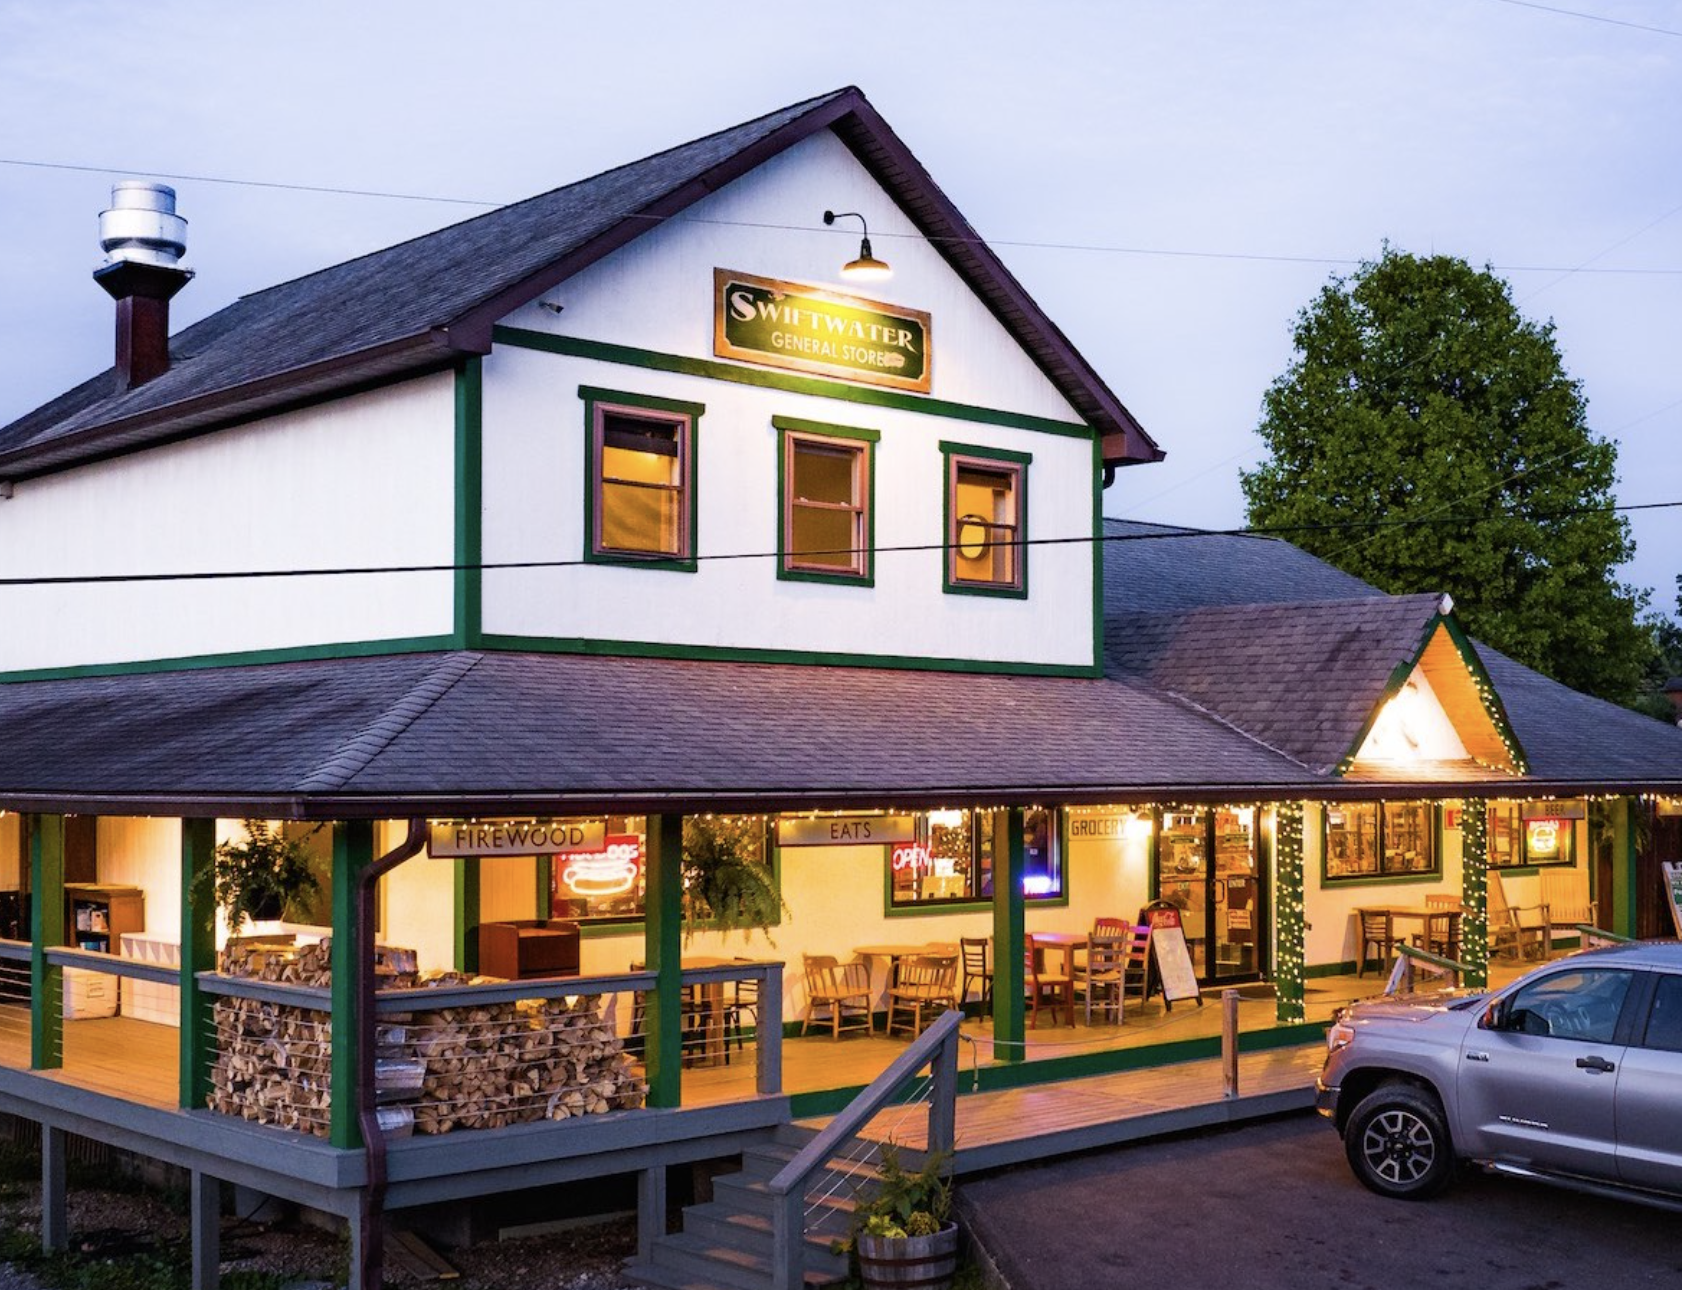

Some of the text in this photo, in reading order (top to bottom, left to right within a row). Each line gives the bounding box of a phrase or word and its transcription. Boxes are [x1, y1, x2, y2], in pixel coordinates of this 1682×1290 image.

[730, 291, 916, 353] SWIFTWATER
[771, 331, 884, 367] GENERAL STORE
[1544, 803, 1566, 816] BEER
[455, 827, 584, 849] FIREWOOD
[830, 822, 871, 840] EATS
[892, 847, 930, 870] OPEN
